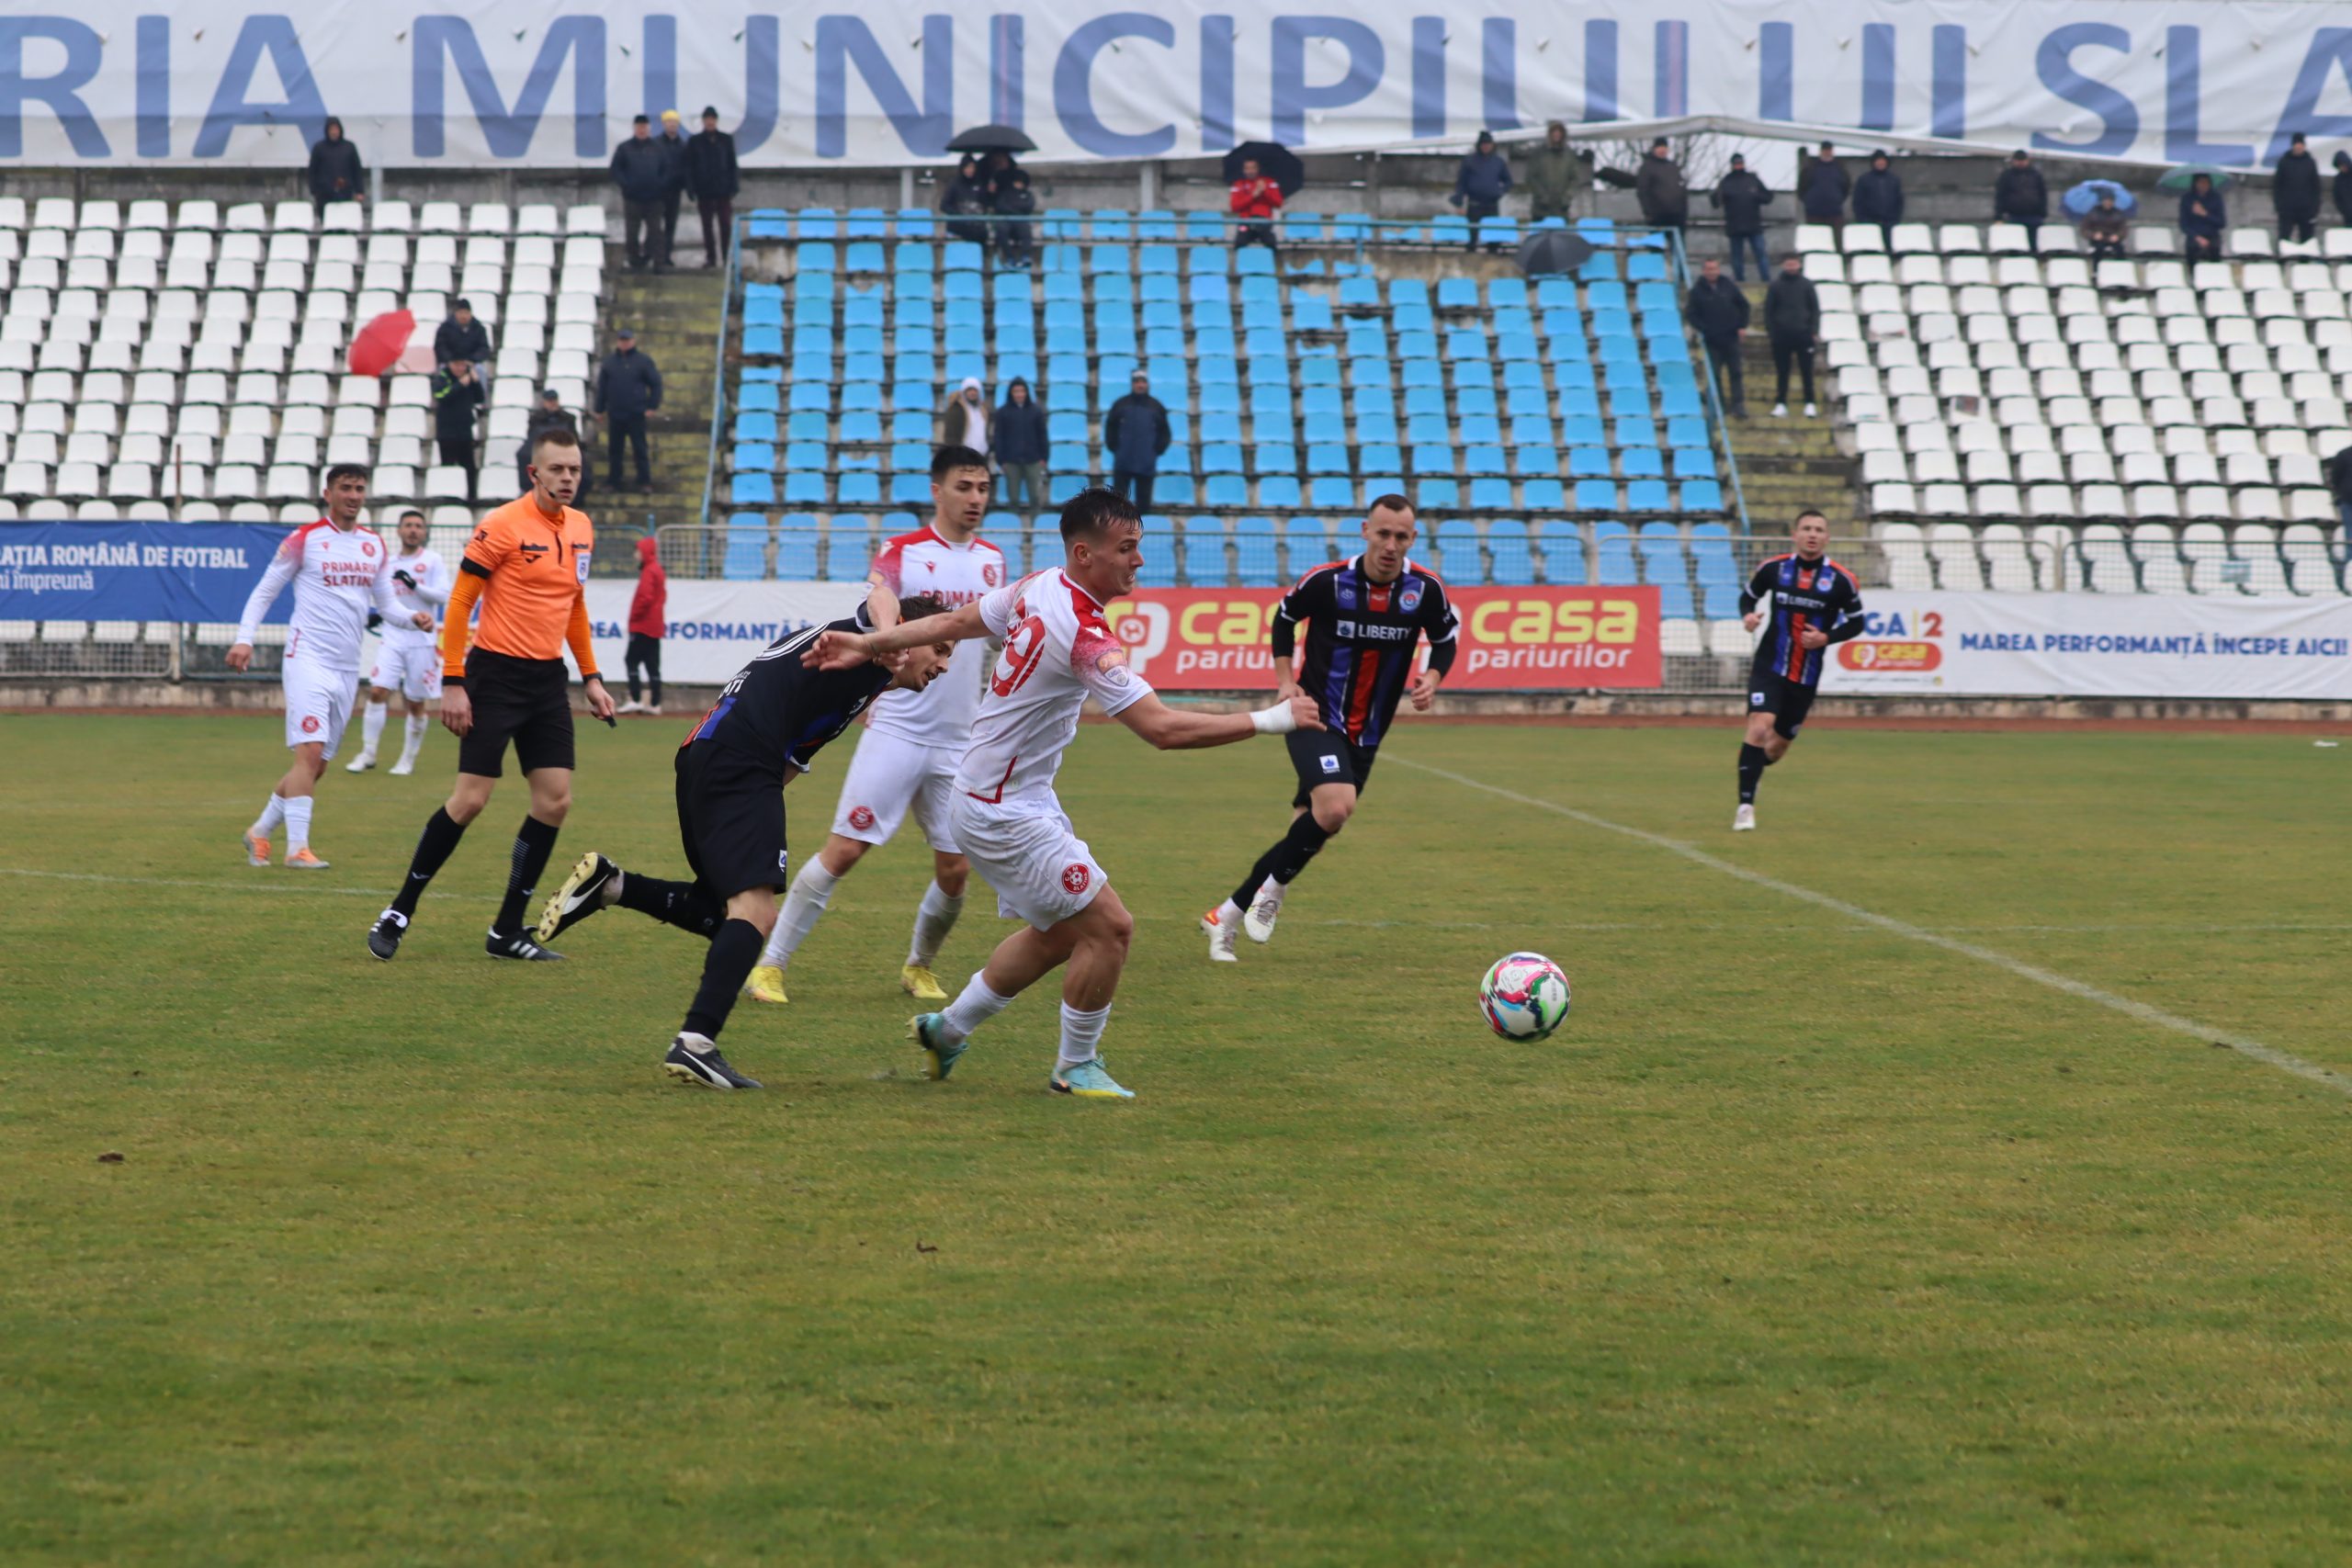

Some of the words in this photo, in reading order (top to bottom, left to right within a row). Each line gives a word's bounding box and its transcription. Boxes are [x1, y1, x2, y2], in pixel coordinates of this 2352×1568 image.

[0, 545, 48, 570] AȚIA
[51, 541, 139, 567] ROMÂNĂ
[143, 546, 168, 567] DE
[172, 547, 249, 569] FOTBAL
[1358, 624, 1413, 641] LIBERTY
[1472, 600, 1639, 644] casa
[1923, 612, 1943, 637] 2
[1961, 633, 2037, 651] MAREA
[1467, 644, 1633, 673] pariurilor
